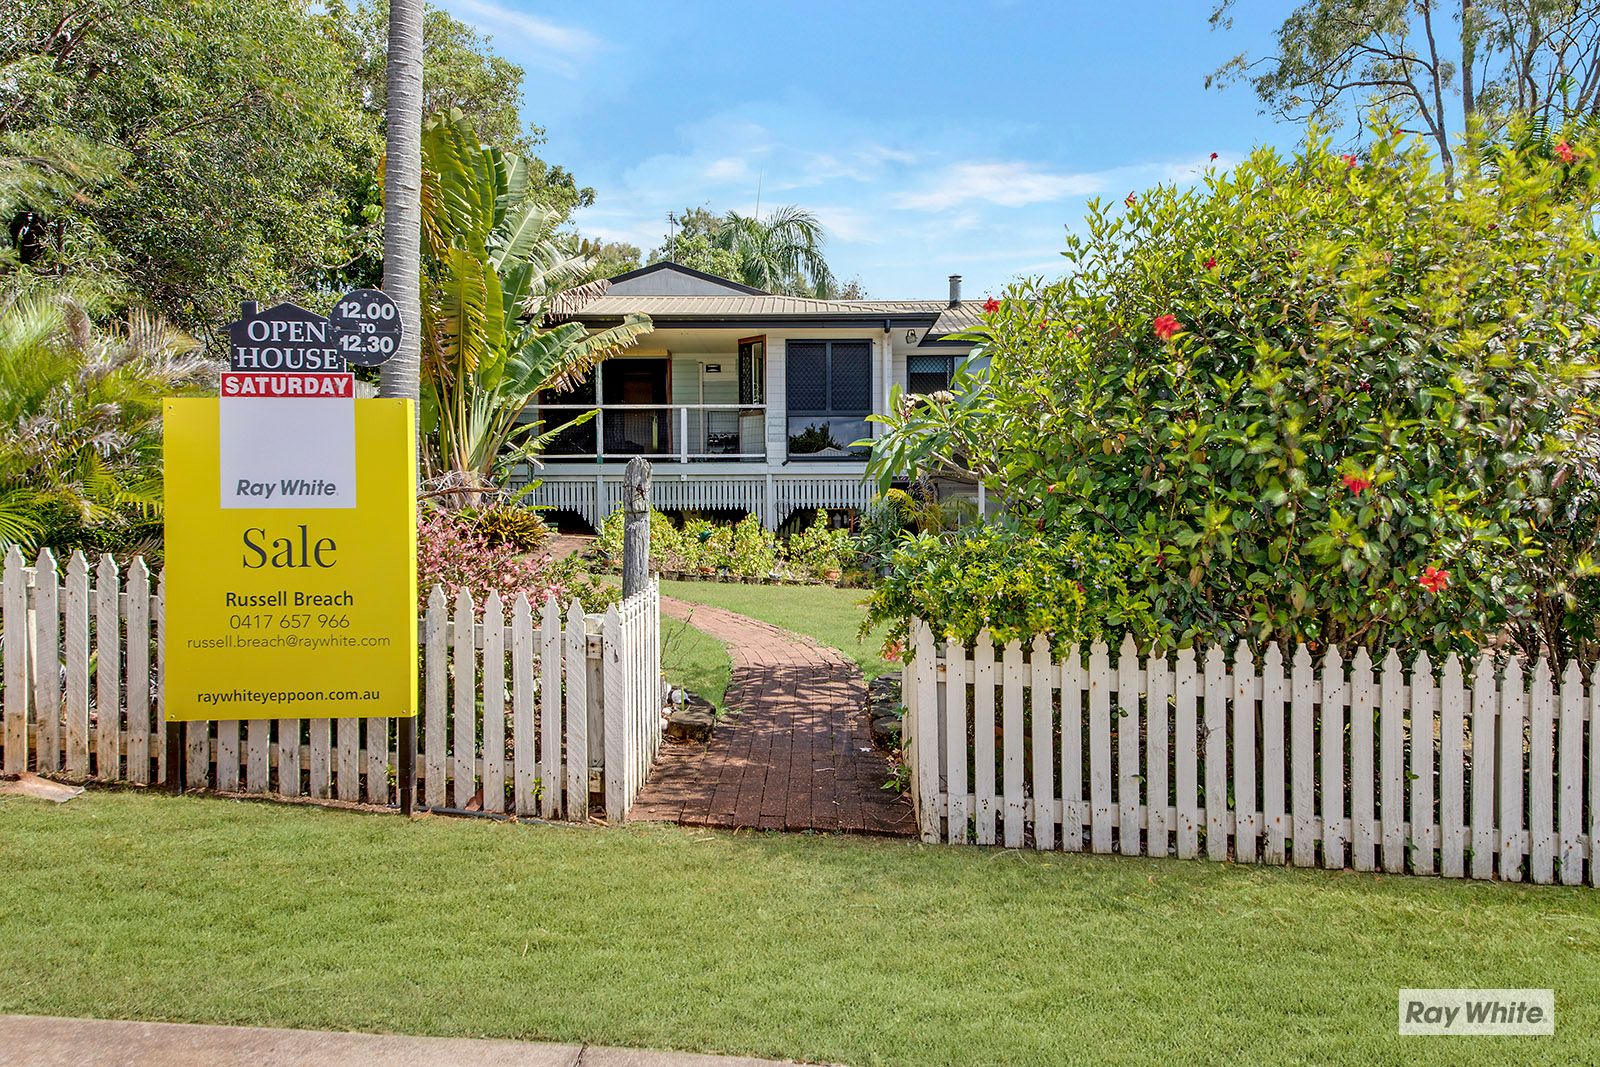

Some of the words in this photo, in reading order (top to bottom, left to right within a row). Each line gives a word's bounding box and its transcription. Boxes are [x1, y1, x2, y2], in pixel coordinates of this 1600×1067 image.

[339, 302, 395, 320] 12.00
[247, 320, 327, 343] OPEN
[359, 322, 376, 334] TO
[339, 335, 394, 353] 12.30
[236, 347, 339, 370] HOUSE
[225, 376, 349, 395] SATURDAY
[236, 478, 277, 499] Ray
[281, 478, 336, 496] White
[242, 524, 337, 569] Sale
[225, 591, 287, 607] Russell
[294, 590, 354, 606] Breach
[229, 614, 272, 629] 0417
[279, 614, 311, 629] 657
[318, 613, 350, 629] 966
[187, 634, 391, 650] russell.breach@raywhite.com
[197, 689, 380, 705] raywhiteyeppoon.com.au
